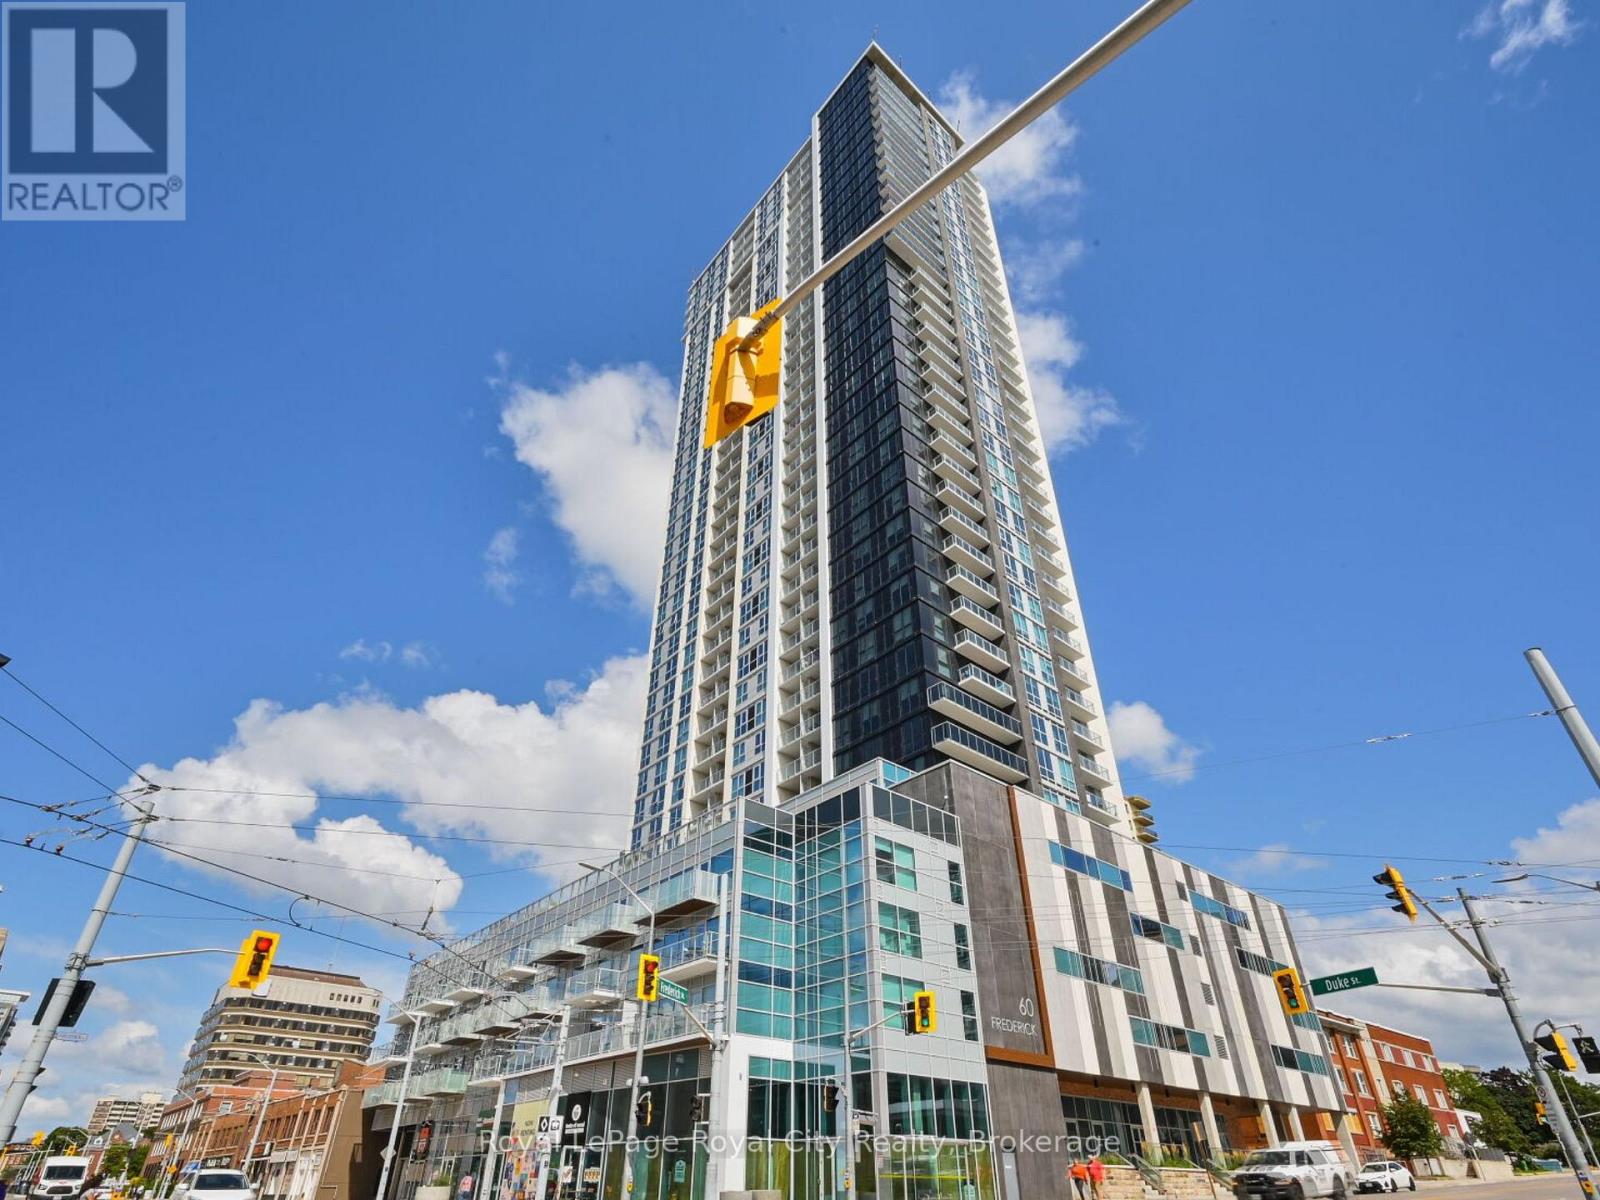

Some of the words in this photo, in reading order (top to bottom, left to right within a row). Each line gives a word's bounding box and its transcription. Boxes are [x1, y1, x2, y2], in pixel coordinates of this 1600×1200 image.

[1325, 977, 1350, 991] Duke
[1019, 996, 1034, 1017] 60
[991, 1016, 1037, 1037] FREDERICK
